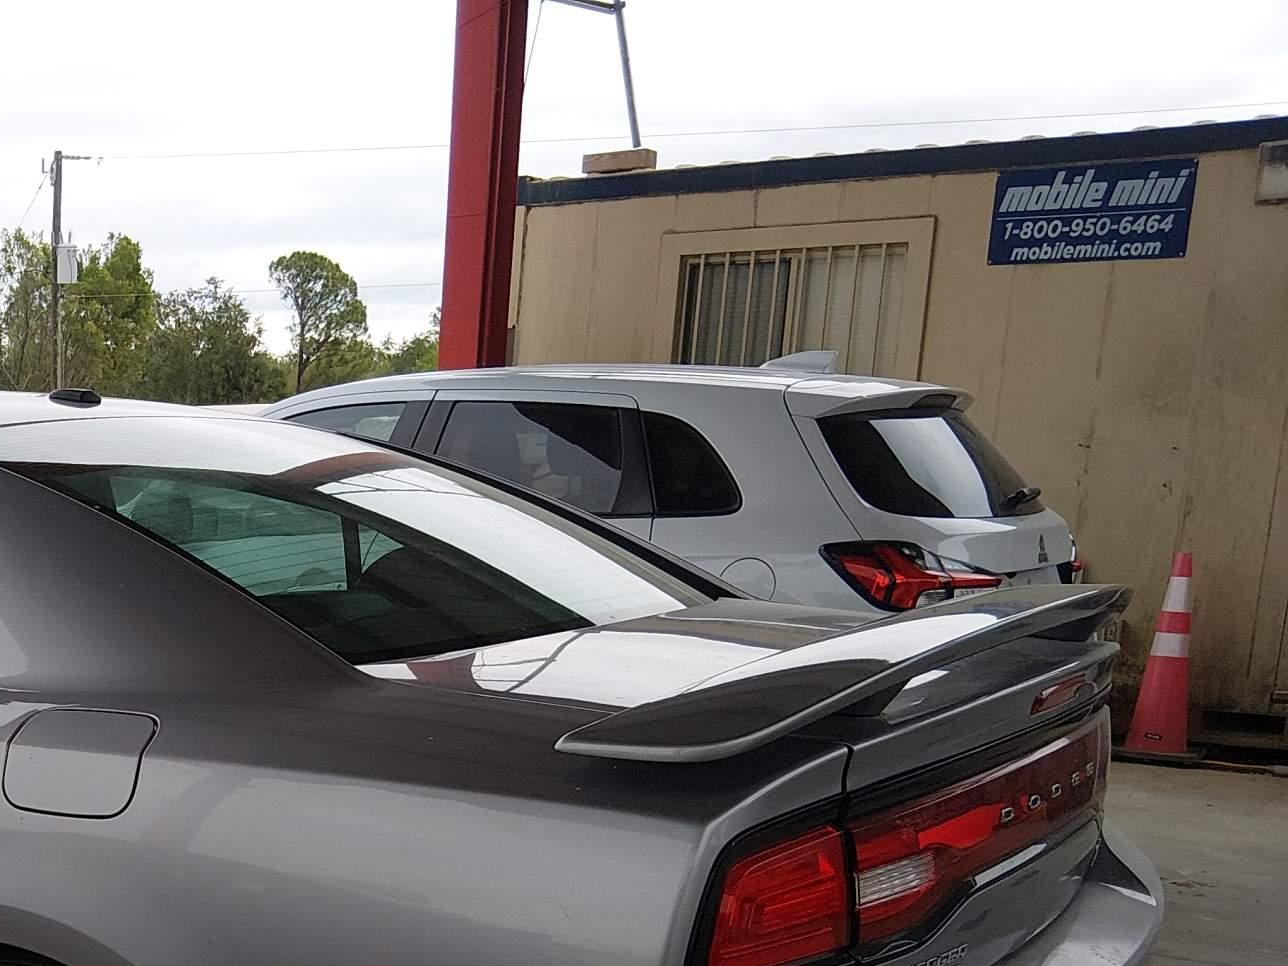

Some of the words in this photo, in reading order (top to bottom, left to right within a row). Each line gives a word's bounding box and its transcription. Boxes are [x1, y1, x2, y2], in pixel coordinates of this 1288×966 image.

[999, 169, 1108, 212] mobile
[1108, 168, 1189, 206] mini
[1004, 214, 1175, 240] 1-800-950-6464
[1010, 240, 1161, 261] mobilemini.com
[1001, 762, 1094, 822] DODGE
